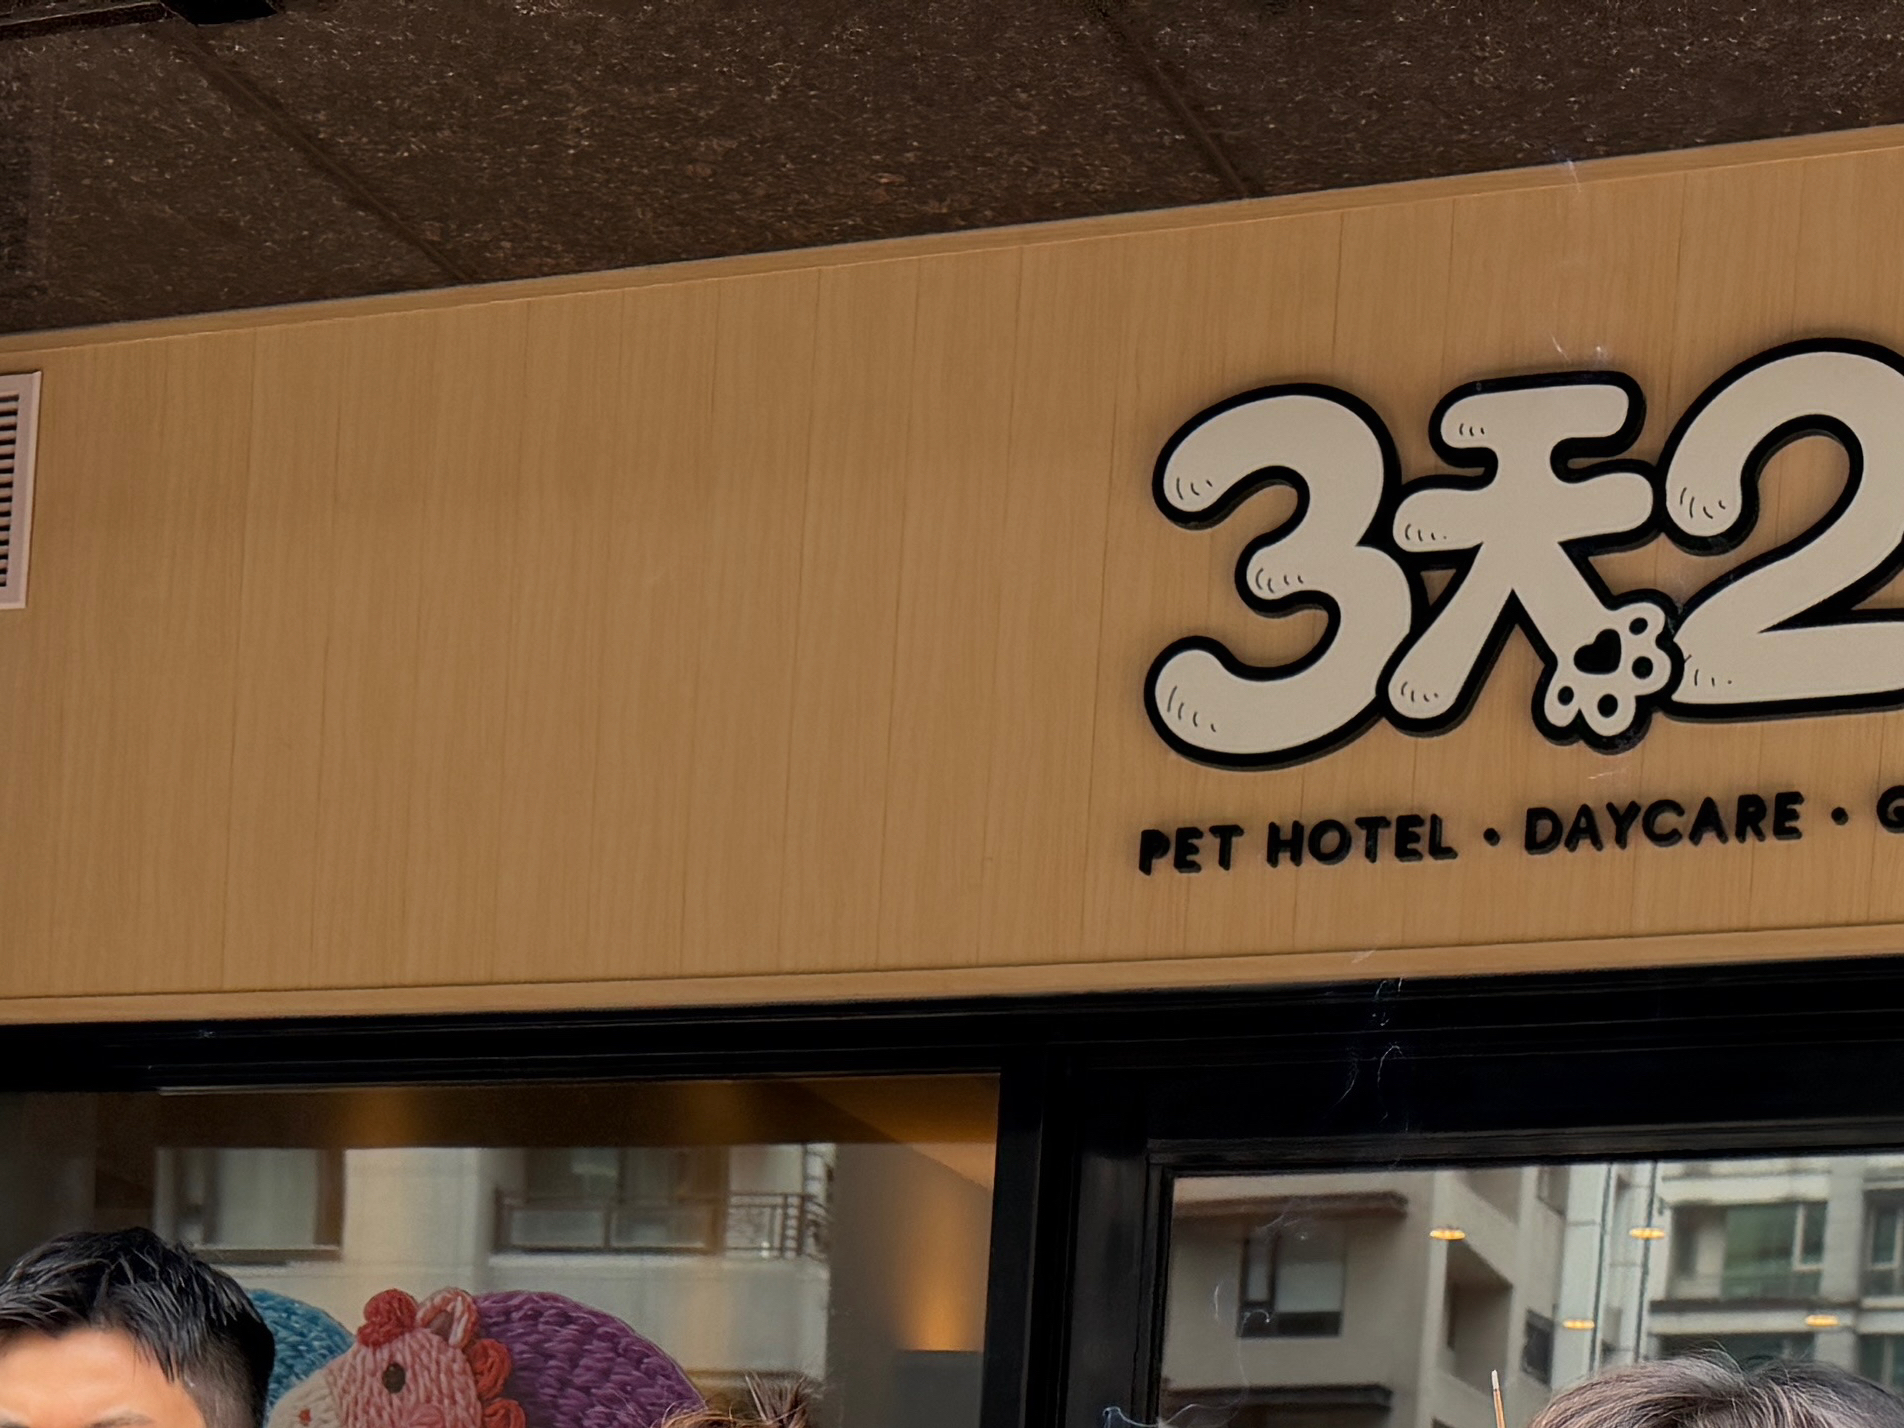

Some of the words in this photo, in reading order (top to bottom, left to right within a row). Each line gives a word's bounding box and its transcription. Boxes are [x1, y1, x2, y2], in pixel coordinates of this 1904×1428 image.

[1138, 821, 1243, 876] PET
[1266, 813, 1459, 868] HOTEL
[1523, 790, 1805, 855] DAYCARE
